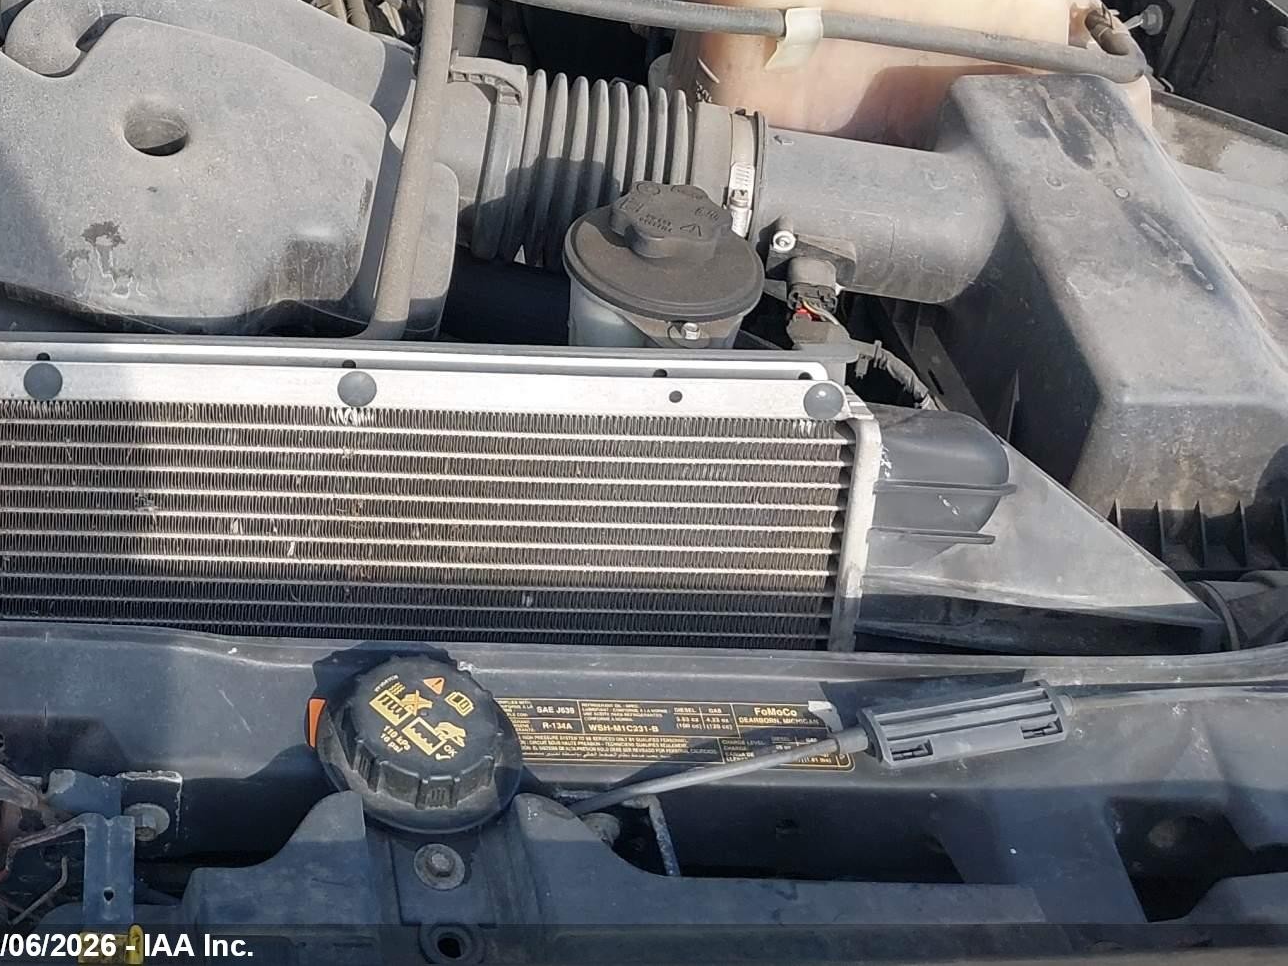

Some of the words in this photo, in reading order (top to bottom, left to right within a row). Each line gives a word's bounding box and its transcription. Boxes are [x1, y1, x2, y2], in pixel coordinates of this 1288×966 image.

[754, 707, 797, 717] FoMoCo
[542, 722, 573, 730] R-134A
[588, 724, 659, 732] WSH-M1C231-B
[383, 725, 398, 739] 110
[395, 735, 411, 751] kPa
[443, 744, 458, 758] OK
